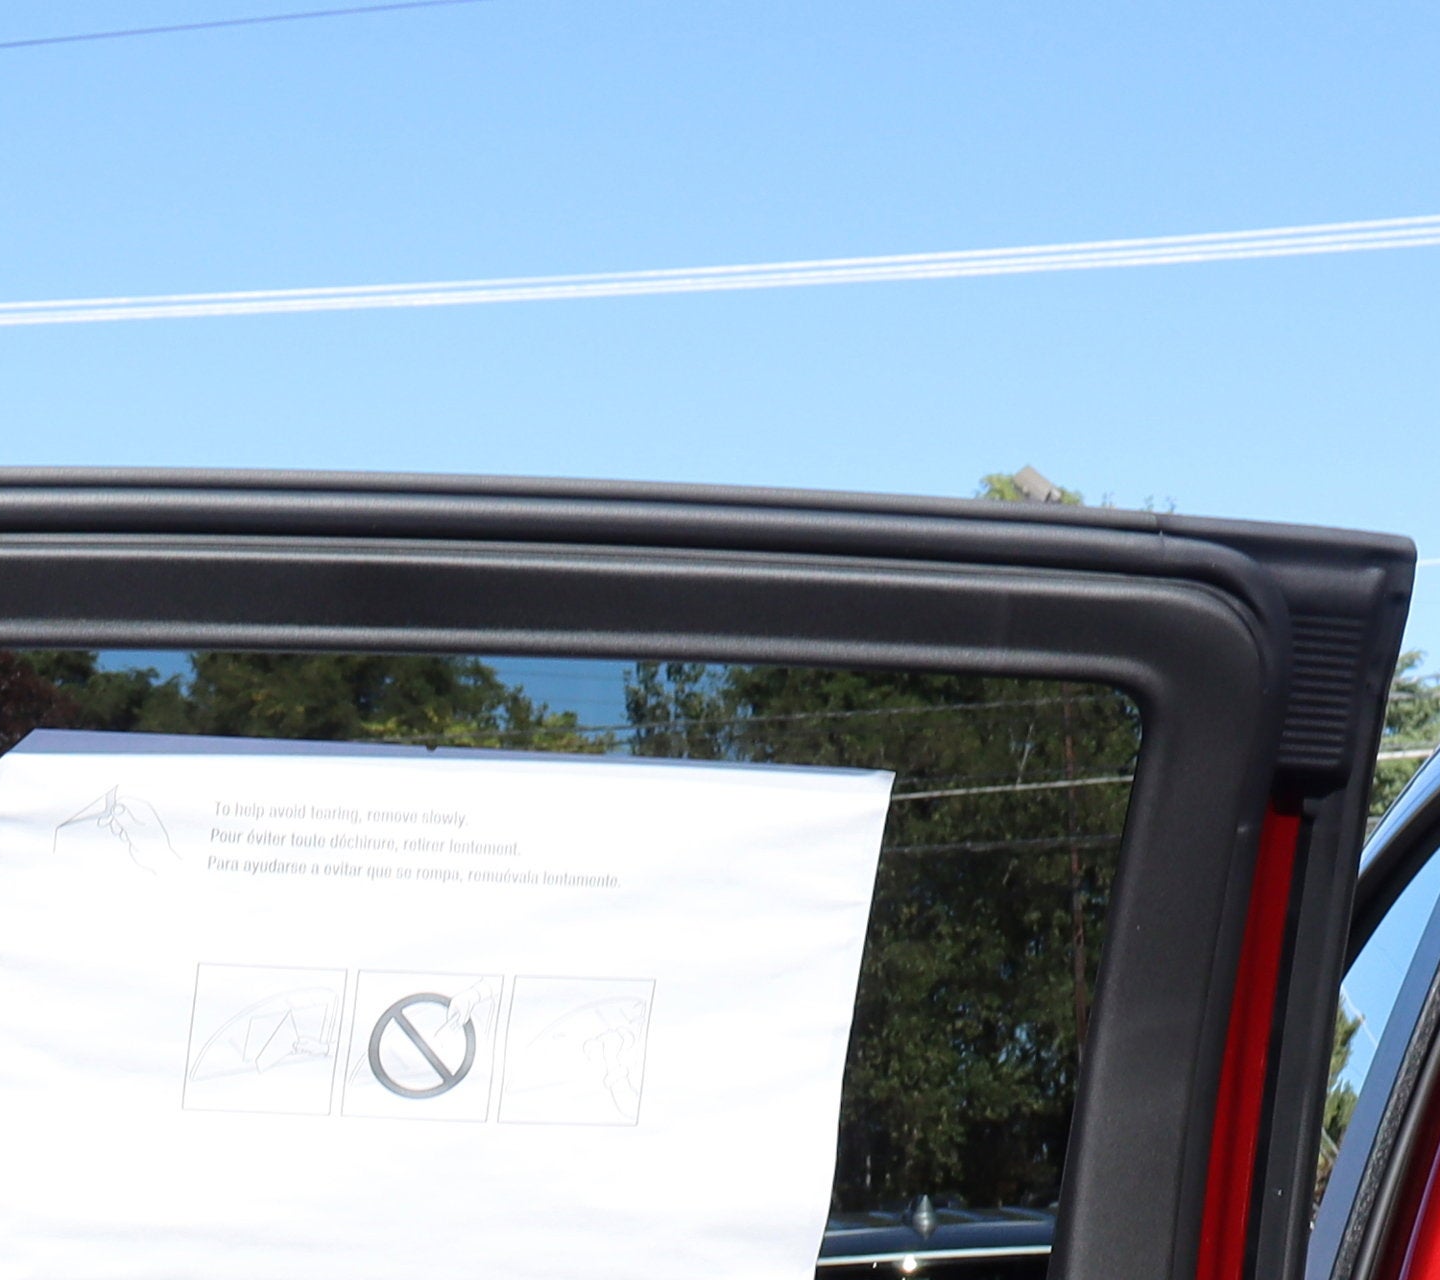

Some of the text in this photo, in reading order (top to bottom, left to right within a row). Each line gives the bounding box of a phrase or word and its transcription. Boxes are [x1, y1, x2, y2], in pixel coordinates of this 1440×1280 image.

[215, 800, 232, 817] To
[234, 801, 266, 822] help
[269, 803, 307, 820] avoid
[311, 805, 363, 825] tearing,
[367, 810, 419, 824] remove
[210, 826, 245, 845] Pour
[246, 827, 287, 847] éviter
[290, 831, 327, 849] toute
[402, 837, 446, 853] retirer
[207, 854, 240, 872] Para
[243, 857, 308, 877] ayudarse
[311, 863, 320, 876] a
[324, 860, 364, 877] evitar
[366, 864, 393, 882] que
[396, 867, 412, 880] se
